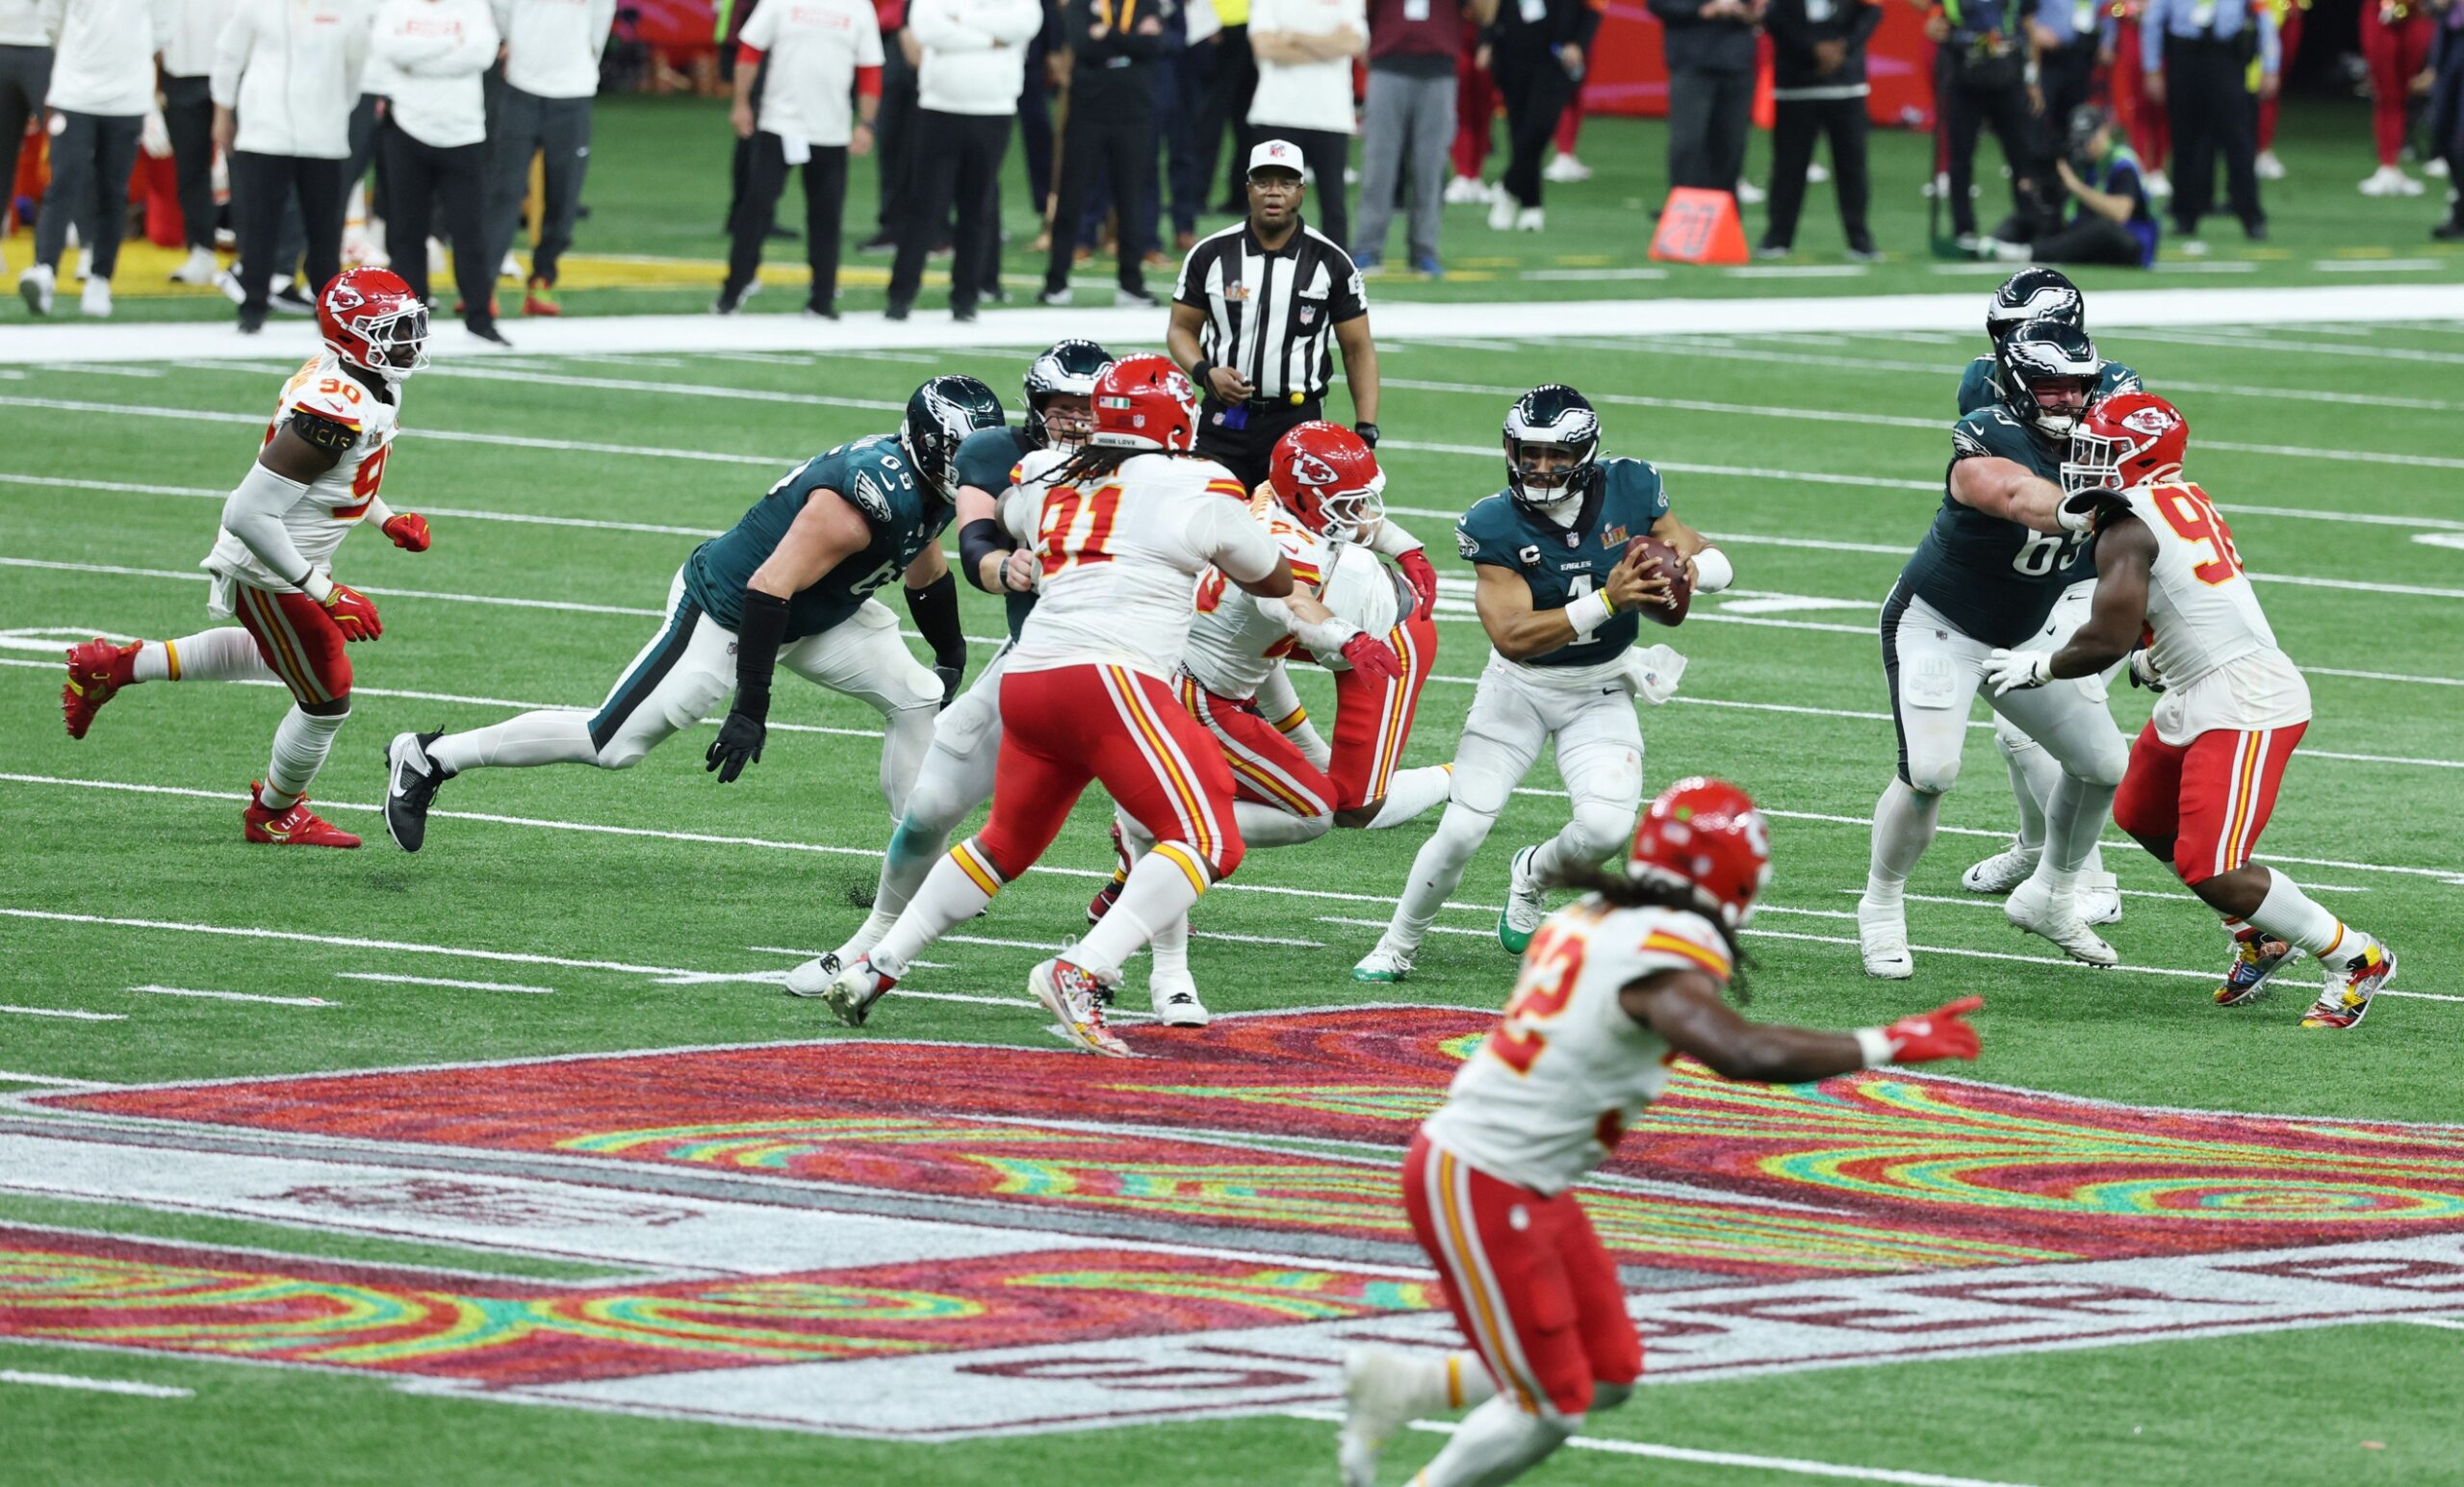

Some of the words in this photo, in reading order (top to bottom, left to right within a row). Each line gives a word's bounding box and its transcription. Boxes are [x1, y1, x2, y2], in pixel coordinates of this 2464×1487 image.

[1657, 200, 1717, 257] 20
[319, 377, 362, 404] 90
[880, 454, 914, 491] 65
[1038, 485, 1124, 577] 91
[1519, 544, 1540, 564] C
[1560, 560, 1592, 571] EAGLES
[1568, 574, 1601, 646] 1
[281, 812, 300, 830] LIX
